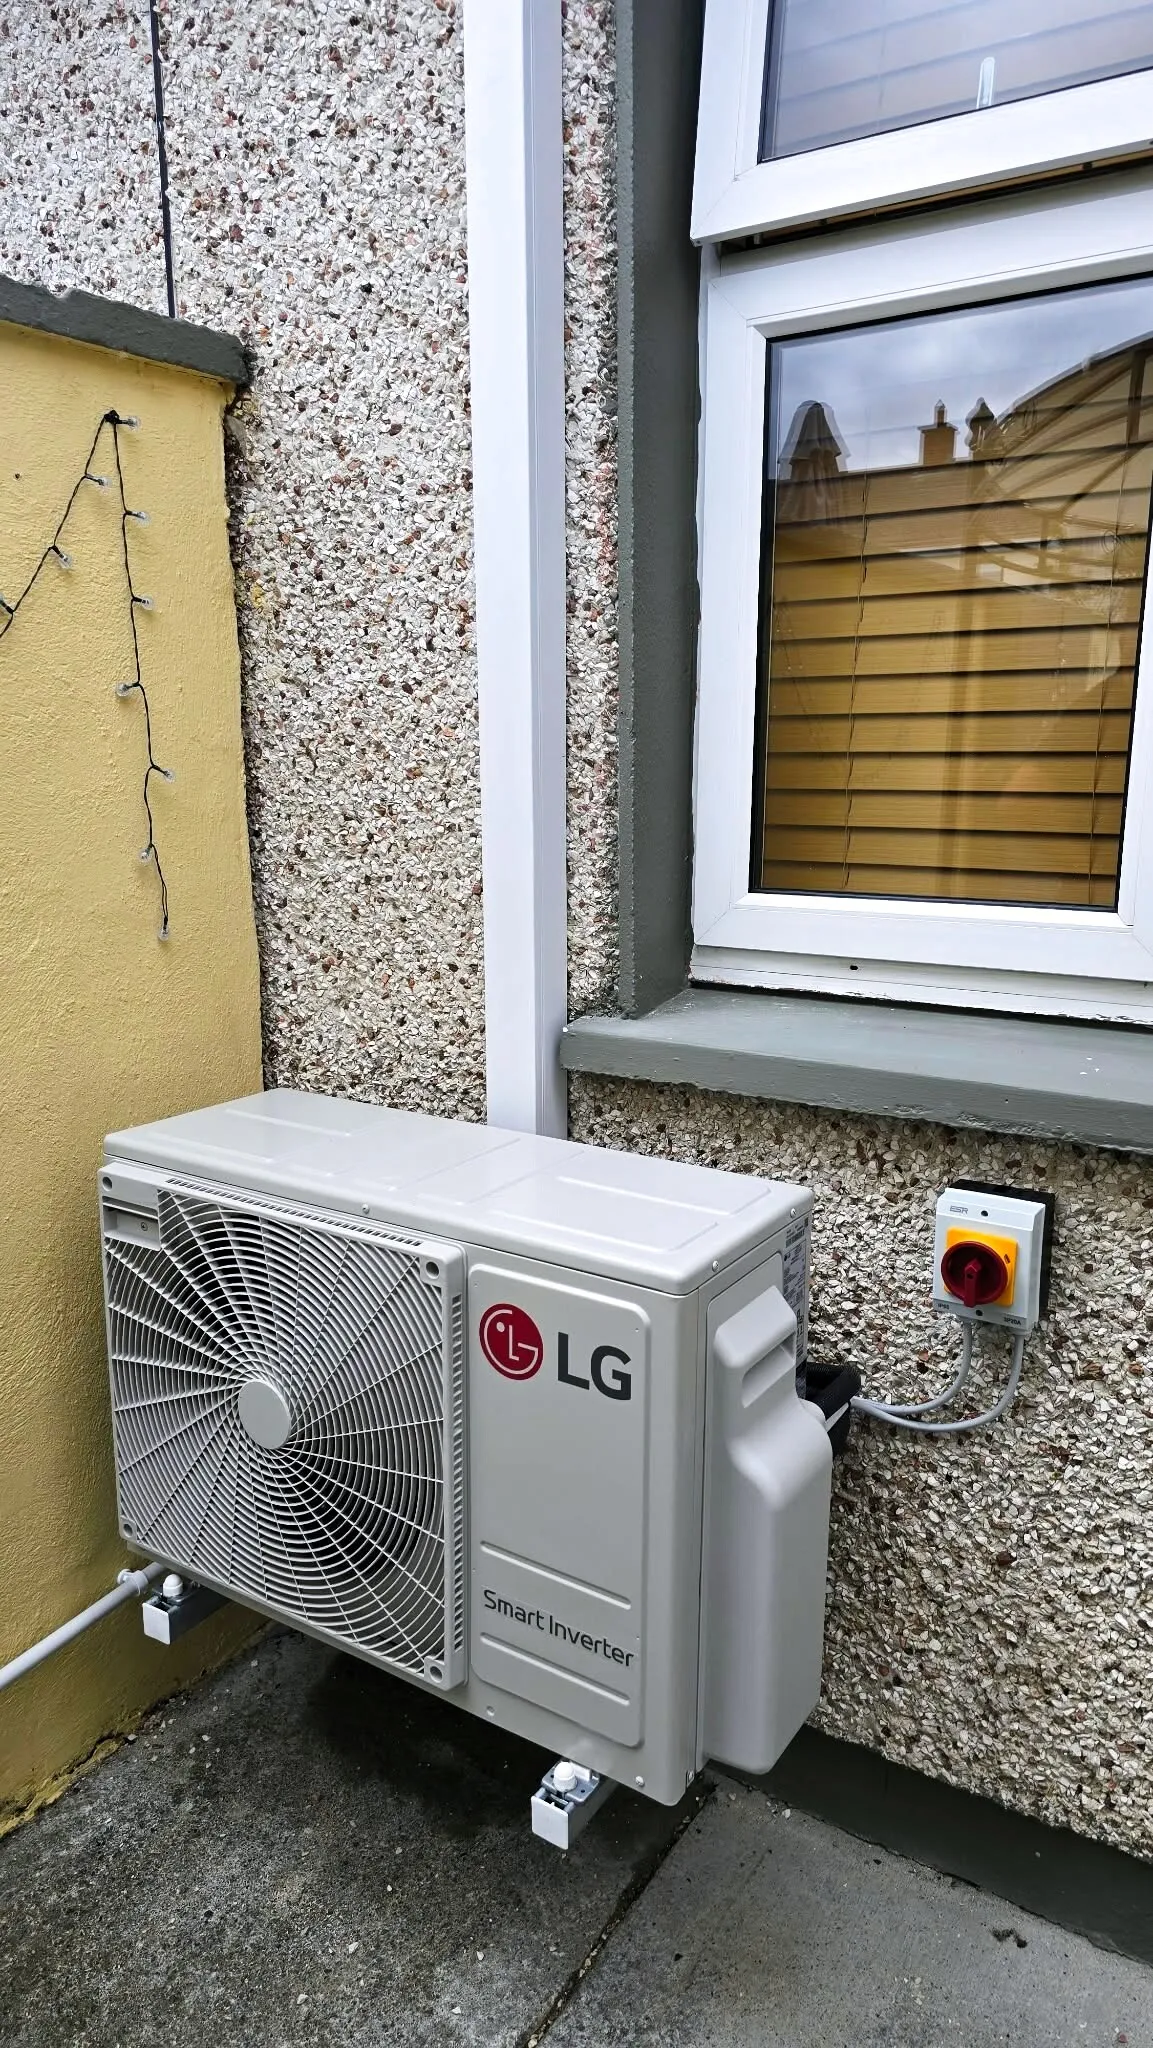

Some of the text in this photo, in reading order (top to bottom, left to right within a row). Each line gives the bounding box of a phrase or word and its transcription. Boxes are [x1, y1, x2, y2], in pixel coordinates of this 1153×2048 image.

[950, 1205, 968, 1214] ESR
[558, 1331, 631, 1400] LG
[483, 1589, 634, 1666] Smart Inverter
